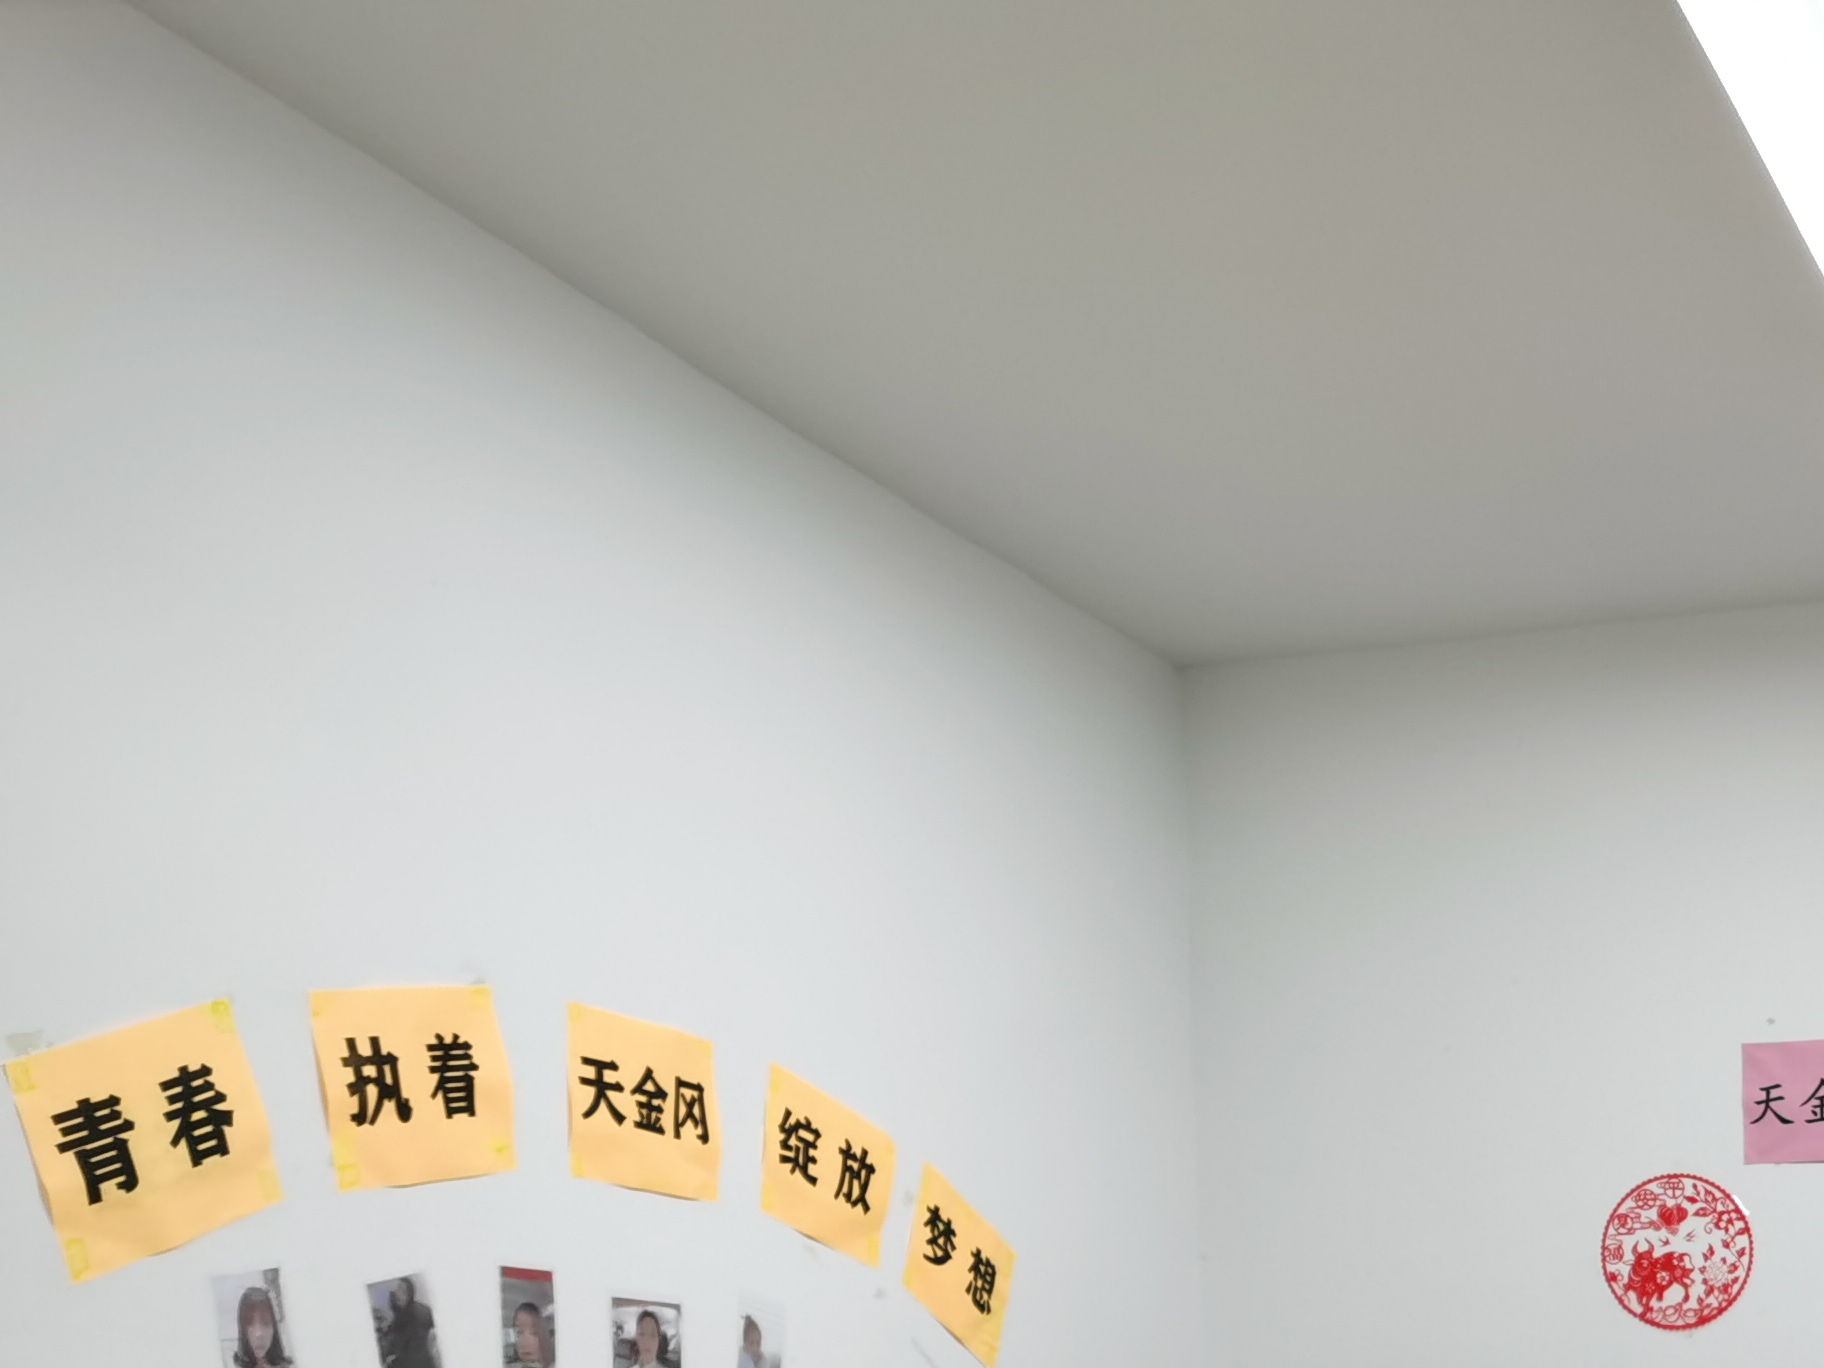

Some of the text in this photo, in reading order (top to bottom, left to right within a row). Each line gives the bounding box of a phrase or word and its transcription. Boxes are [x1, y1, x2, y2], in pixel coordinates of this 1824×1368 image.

[53, 1032, 998, 1317] 青春 执着 天金冈 绽放 梦想
